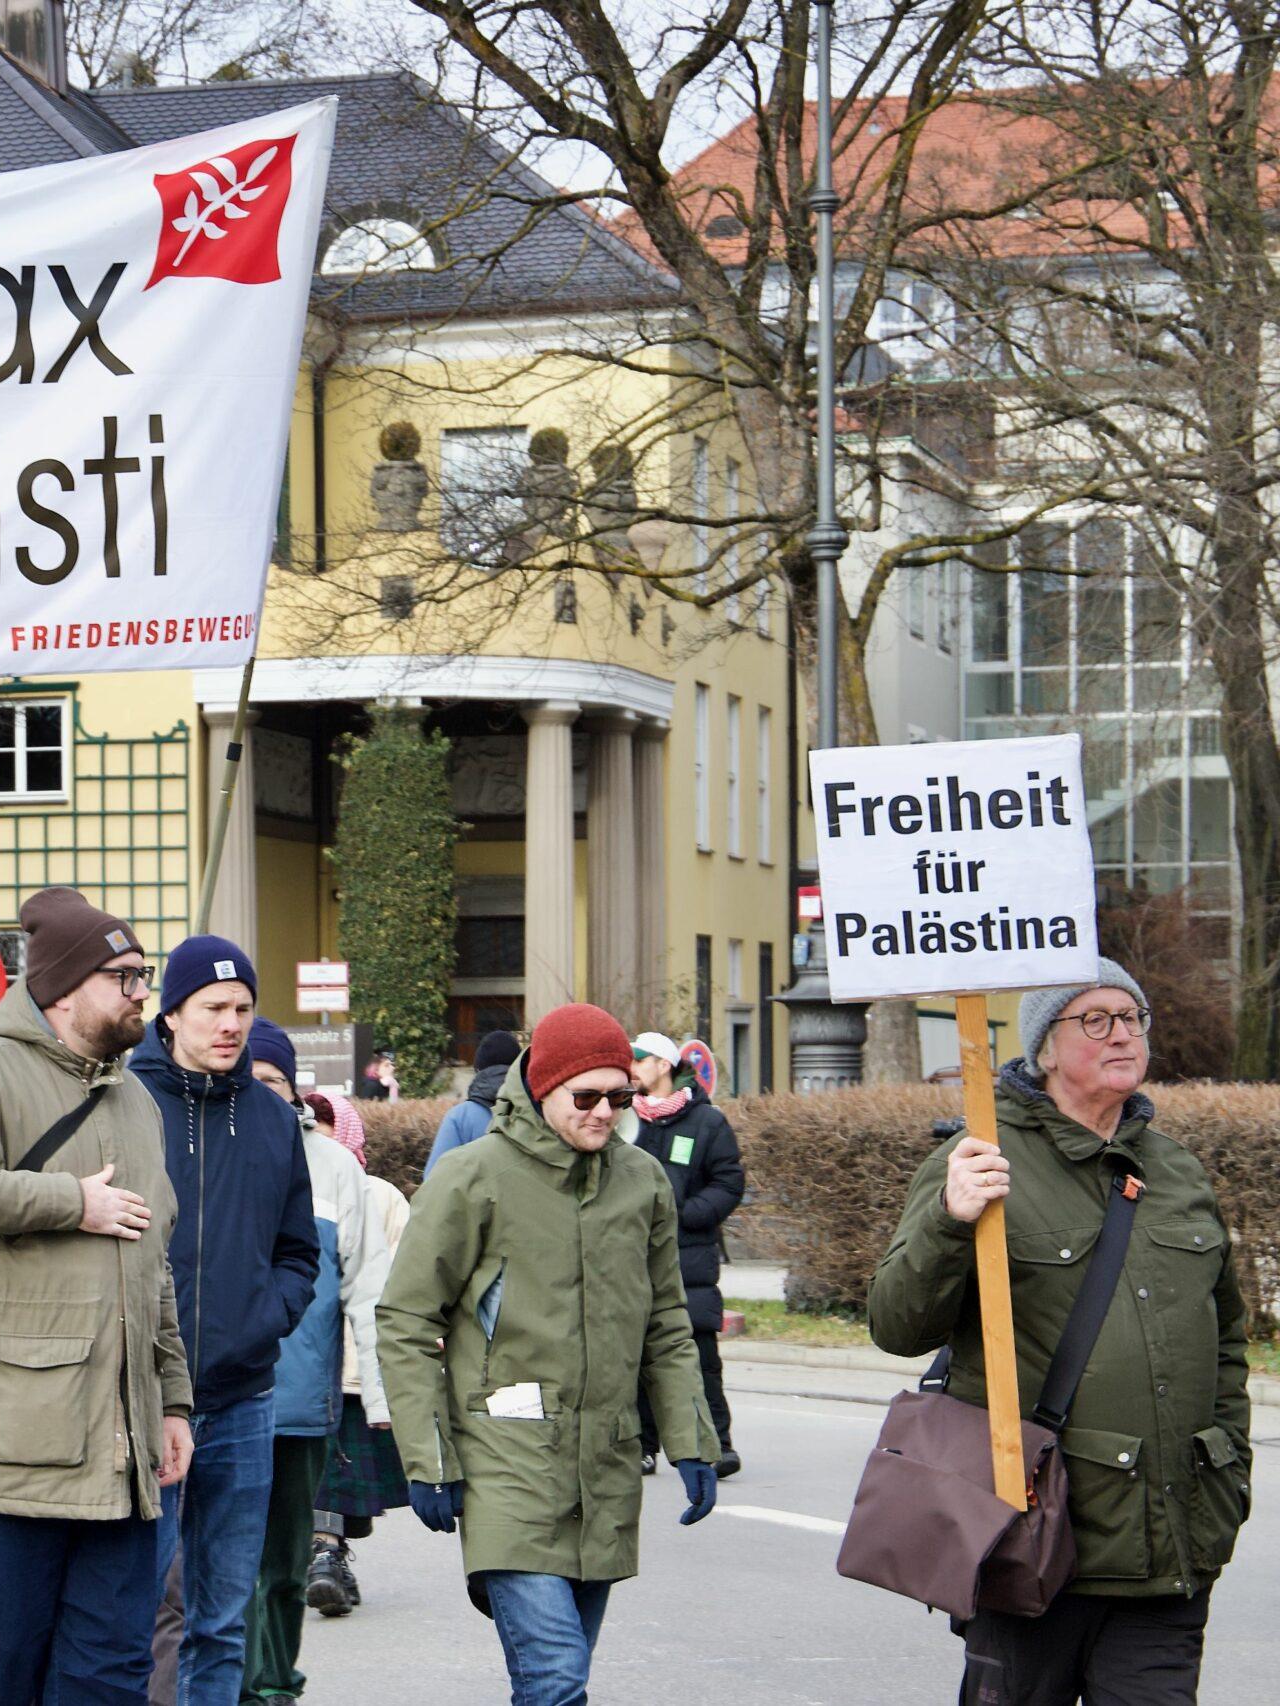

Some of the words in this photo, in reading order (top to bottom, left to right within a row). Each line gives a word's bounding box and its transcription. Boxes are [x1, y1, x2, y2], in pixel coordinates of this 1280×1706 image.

[10, 613, 255, 652] FRIEDENSBEWEGU
[823, 770, 1072, 838] Freiheit
[912, 849, 987, 895] für
[834, 906, 1078, 957] Palästina
